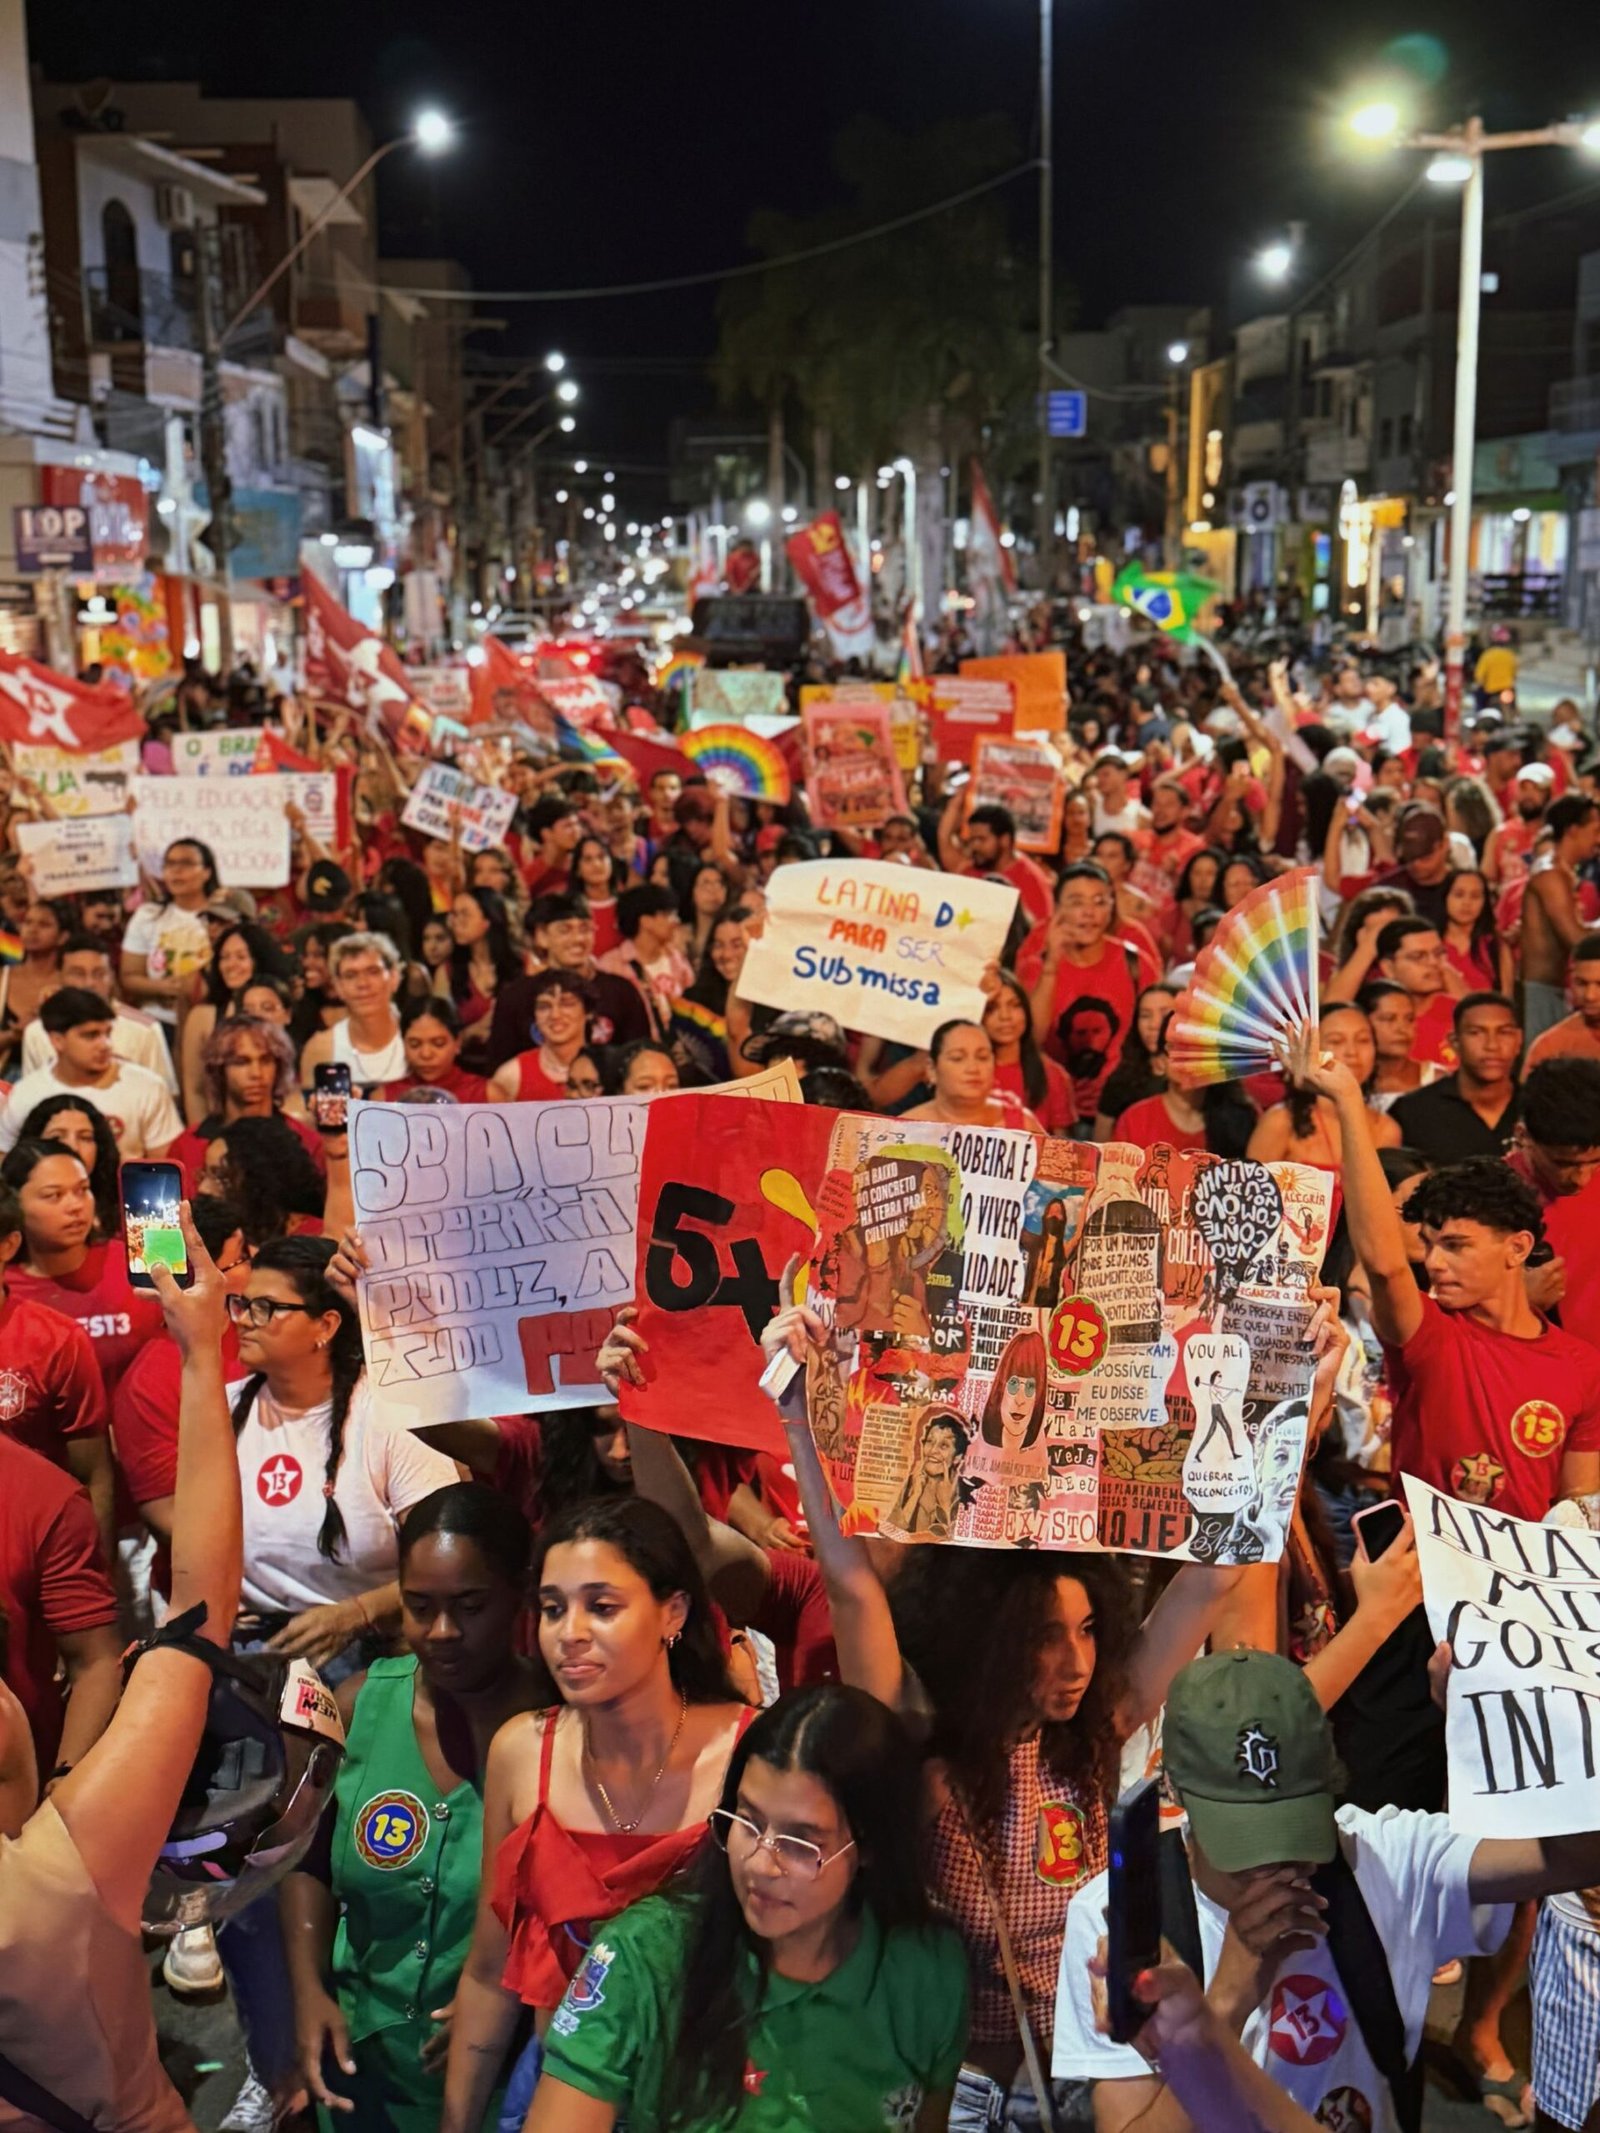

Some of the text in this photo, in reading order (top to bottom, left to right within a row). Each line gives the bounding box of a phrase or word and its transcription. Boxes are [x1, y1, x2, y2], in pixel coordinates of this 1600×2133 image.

[816, 877, 920, 923] LATINA
[829, 919, 945, 967] PARA SER
[463, 1111, 525, 1199] A
[1020, 1134, 1033, 1183] É
[871, 1162, 899, 1185] BAIXO
[870, 1174, 917, 1205] CONCRETO
[860, 1191, 928, 1228] HÁ TERRA PARA
[977, 1194, 1021, 1241] VIVER
[1194, 1194, 1241, 1221] OVO
[1105, 1237, 1118, 1252] UM
[1122, 1235, 1155, 1251] MUNDO
[1199, 1221, 1269, 1249] CONTE
[574, 1247, 630, 1299] A
[979, 1306, 1033, 1327] MULHERES
[1221, 1316, 1241, 1330] QUE
[1274, 1323, 1295, 1337] TEM
[1226, 1302, 1247, 1316] MAS
[1248, 1305, 1285, 1321] PRECISA
[1057, 1313, 1099, 1358] 13
[370, 1322, 503, 1387] TUDO
[1187, 1343, 1216, 1360] VOU
[1091, 1384, 1107, 1399] EU
[1076, 1406, 1097, 1421] ME
[1523, 1414, 1557, 1444] 13
[272, 1473, 287, 1491] 13
[1187, 1471, 1234, 1483] QUEBRAR
[1005, 1510, 1096, 1543] EXISTO
[374, 1813, 411, 1847] 13
[1286, 2002, 1321, 2041] 13
